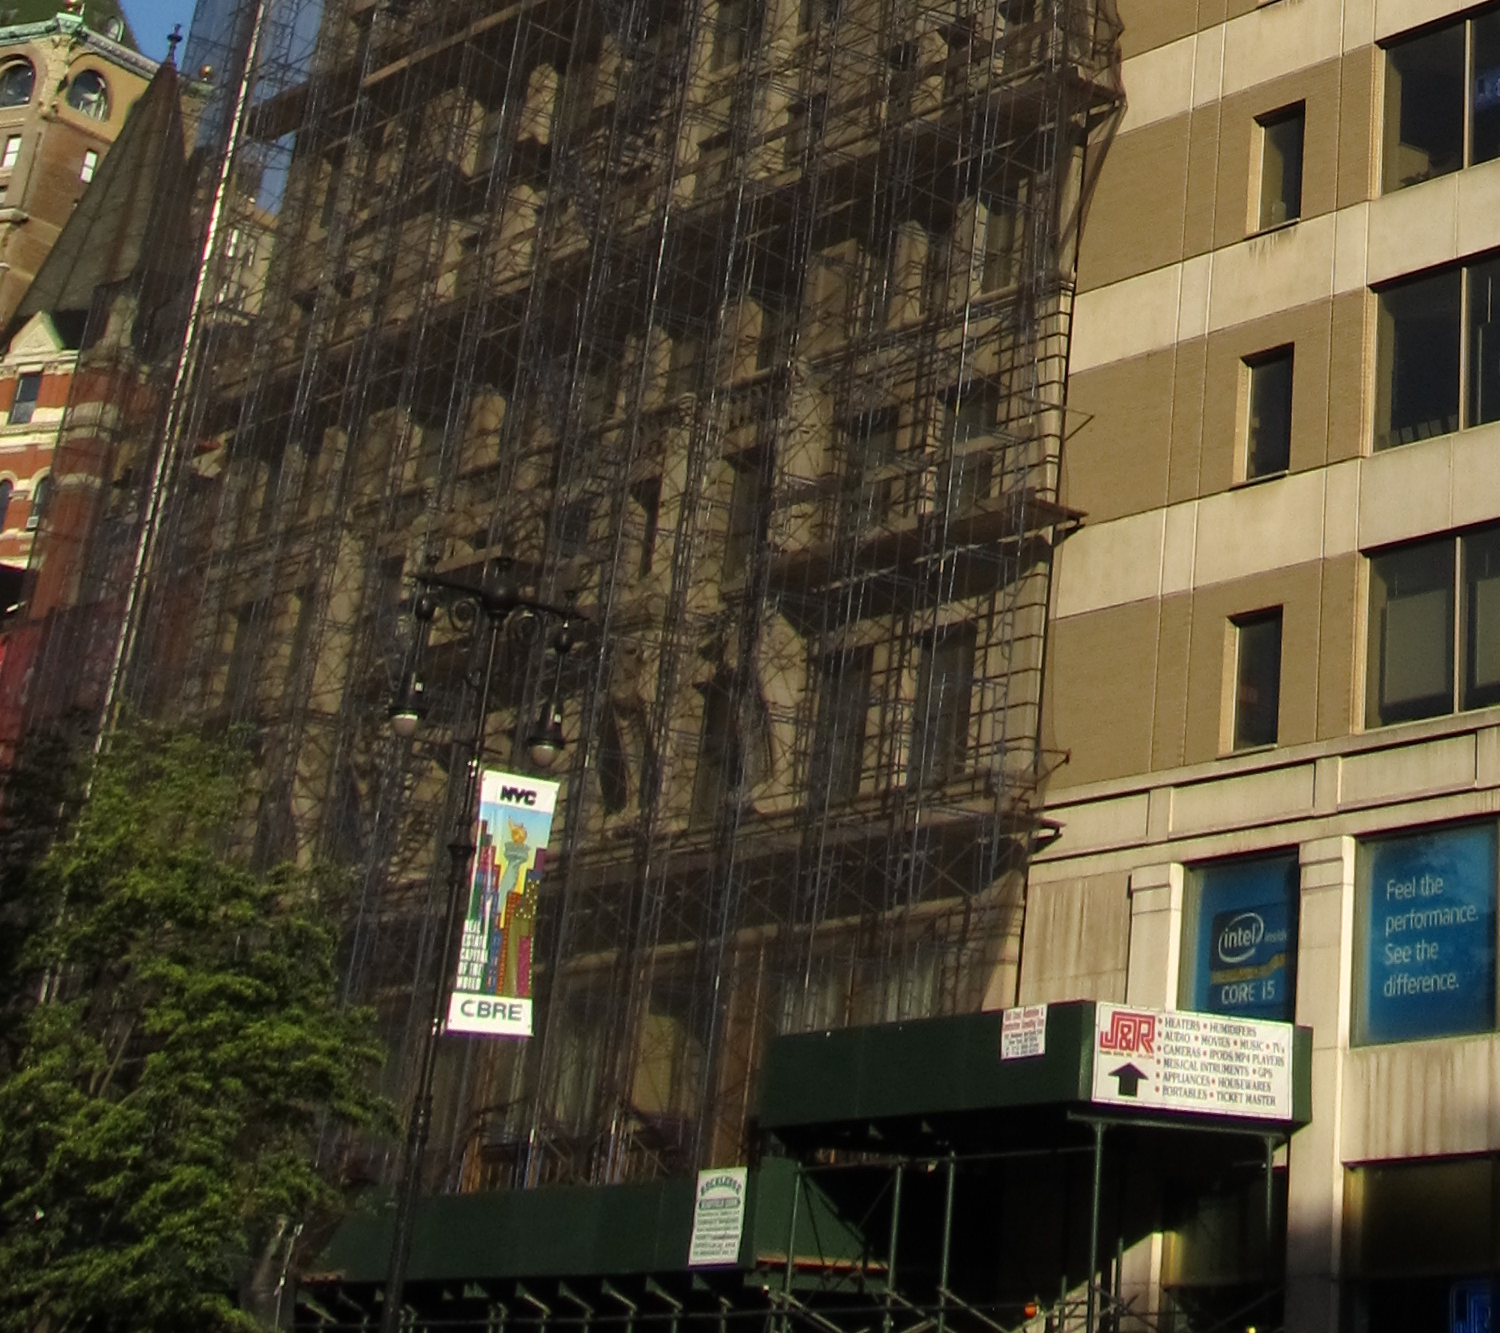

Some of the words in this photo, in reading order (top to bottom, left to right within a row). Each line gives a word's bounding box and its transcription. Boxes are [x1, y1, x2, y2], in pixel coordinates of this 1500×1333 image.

[499, 785, 537, 806] NYC
[1385, 877, 1415, 900] Feel
[1419, 874, 1444, 896] the
[1384, 901, 1479, 937] performance.
[1223, 921, 1256, 949] intel
[1384, 943, 1412, 964] See
[1415, 938, 1439, 962] the
[1221, 981, 1256, 1005] CORE
[1261, 979, 1276, 1001] i5
[1383, 967, 1460, 998] difference.
[460, 999, 523, 1022] CBRE
[1100, 1011, 1156, 1055] J&R
[1164, 1016, 1201, 1031] HEATERS
[1164, 1031, 1191, 1044] AUDIO
[1201, 1035, 1231, 1048] MOVIES
[1240, 1039, 1265, 1052] MUSIC
[1163, 1045, 1201, 1058] CAMERAS
[1252, 1053, 1286, 1067] PLAYERS
[1163, 1058, 1199, 1072] MUSICAL
[1257, 1068, 1274, 1079] GPS
[1162, 1071, 1211, 1086] APPLIANCES
[1217, 1076, 1272, 1092] HOUSEWARES
[1162, 1085, 1208, 1100] PORTABLES
[1215, 1089, 1243, 1103] TICKET
[1244, 1093, 1277, 1107] MASTER
